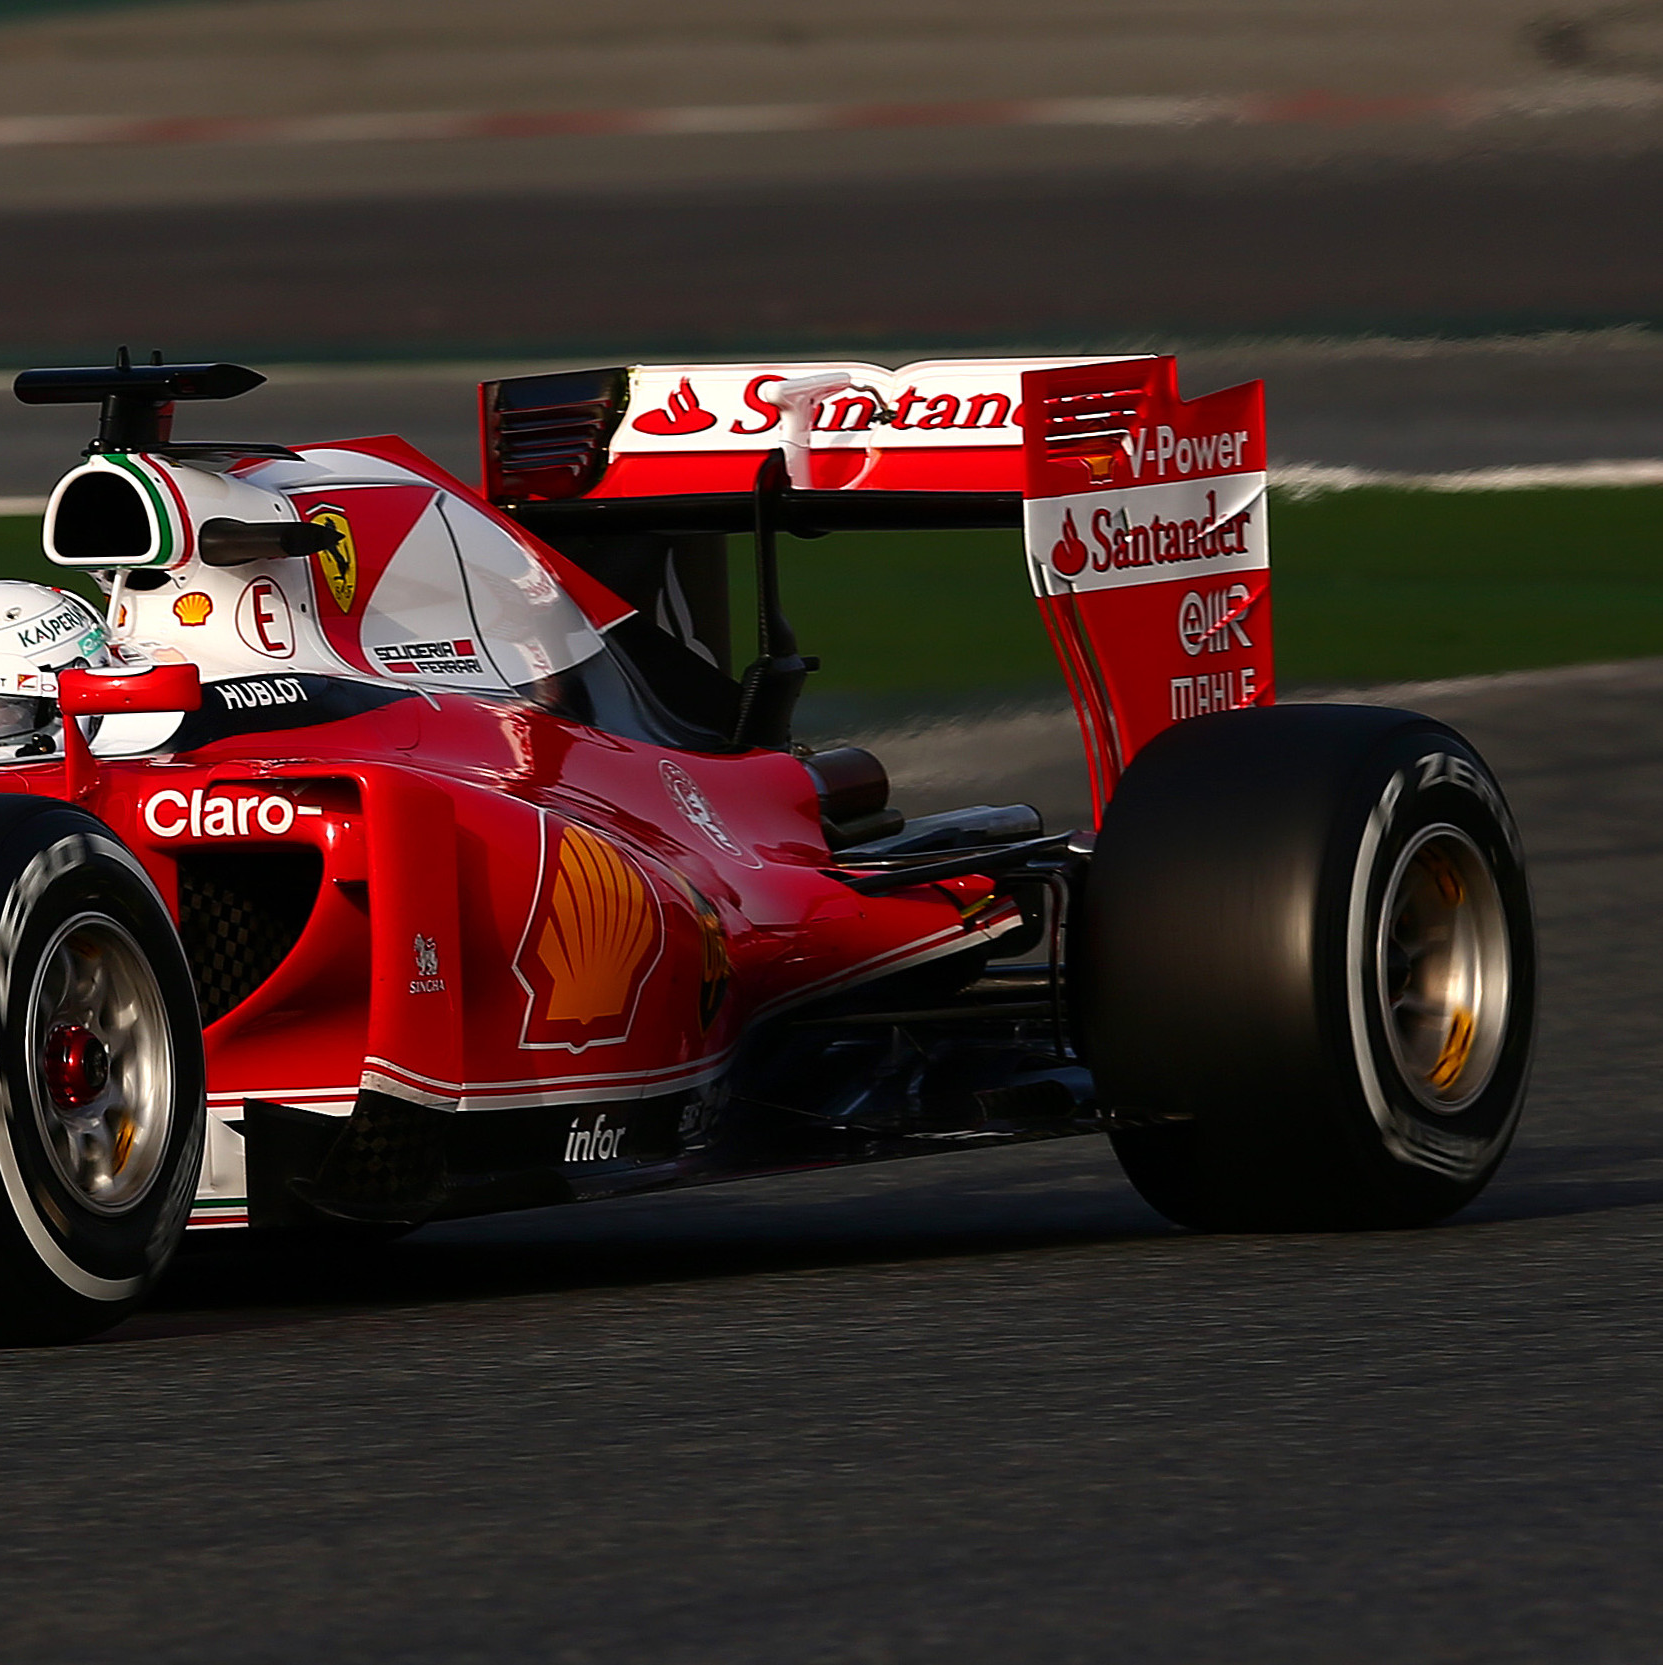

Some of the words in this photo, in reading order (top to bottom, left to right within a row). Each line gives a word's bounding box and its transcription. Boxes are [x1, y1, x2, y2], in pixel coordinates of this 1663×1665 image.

[729, 374, 1026, 434] Sntan
[1128, 425, 1249, 478] V-Power
[1092, 489, 1251, 573] Santander
[252, 583, 287, 652] E
[374, 640, 454, 662] SCUDERIA
[418, 658, 484, 674] FERRARI
[214, 678, 308, 710] HUBLOT
[1170, 667, 1256, 720] MAHLE
[564, 1113, 627, 1162] infor
